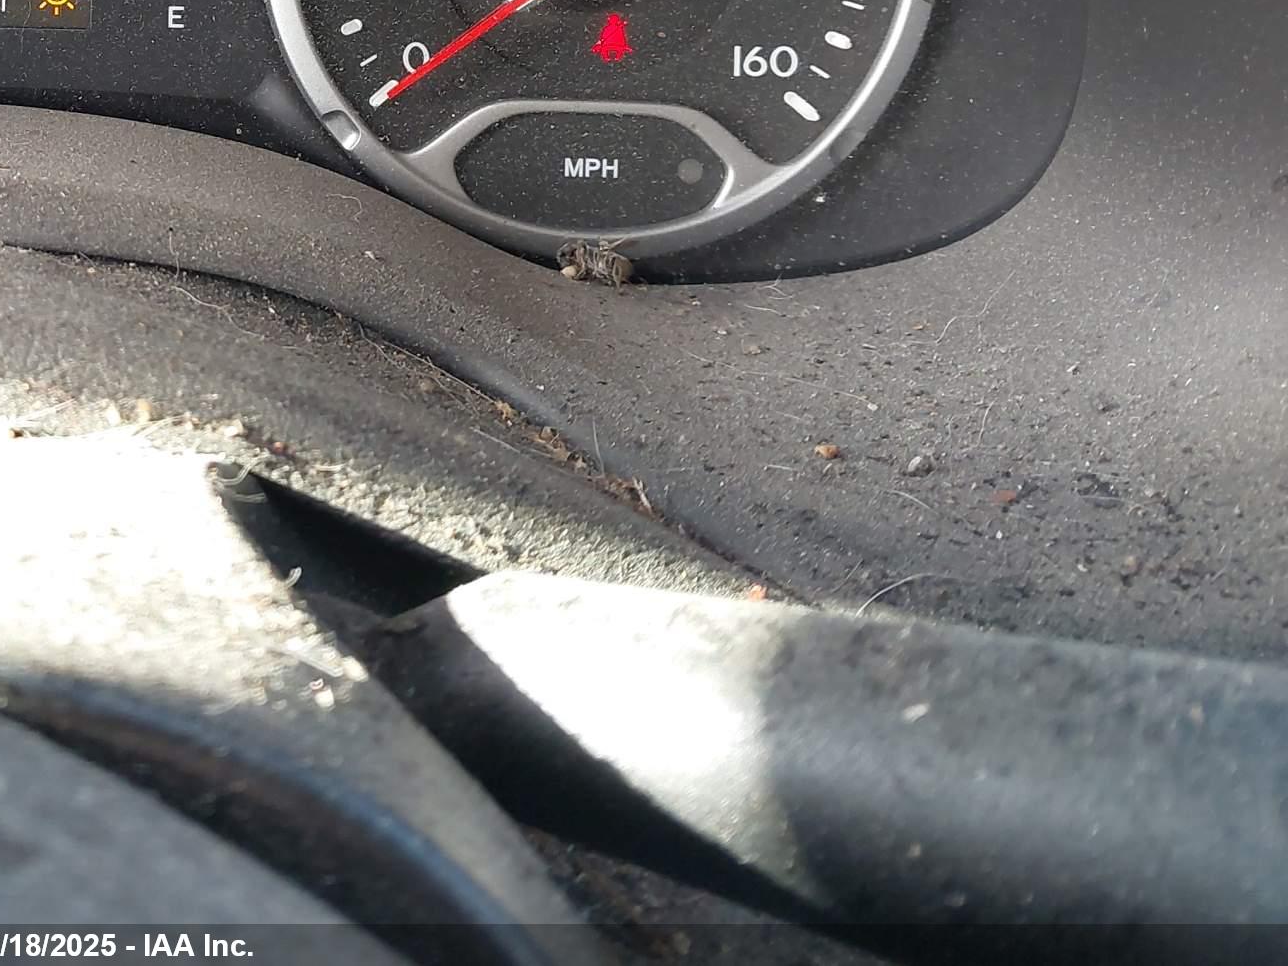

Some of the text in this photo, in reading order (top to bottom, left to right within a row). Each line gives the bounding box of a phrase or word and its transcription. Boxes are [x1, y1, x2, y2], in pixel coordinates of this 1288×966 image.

[168, 6, 184, 28] E
[403, 41, 429, 73] 0
[734, 45, 798, 77] 160
[564, 158, 618, 177] MPH
